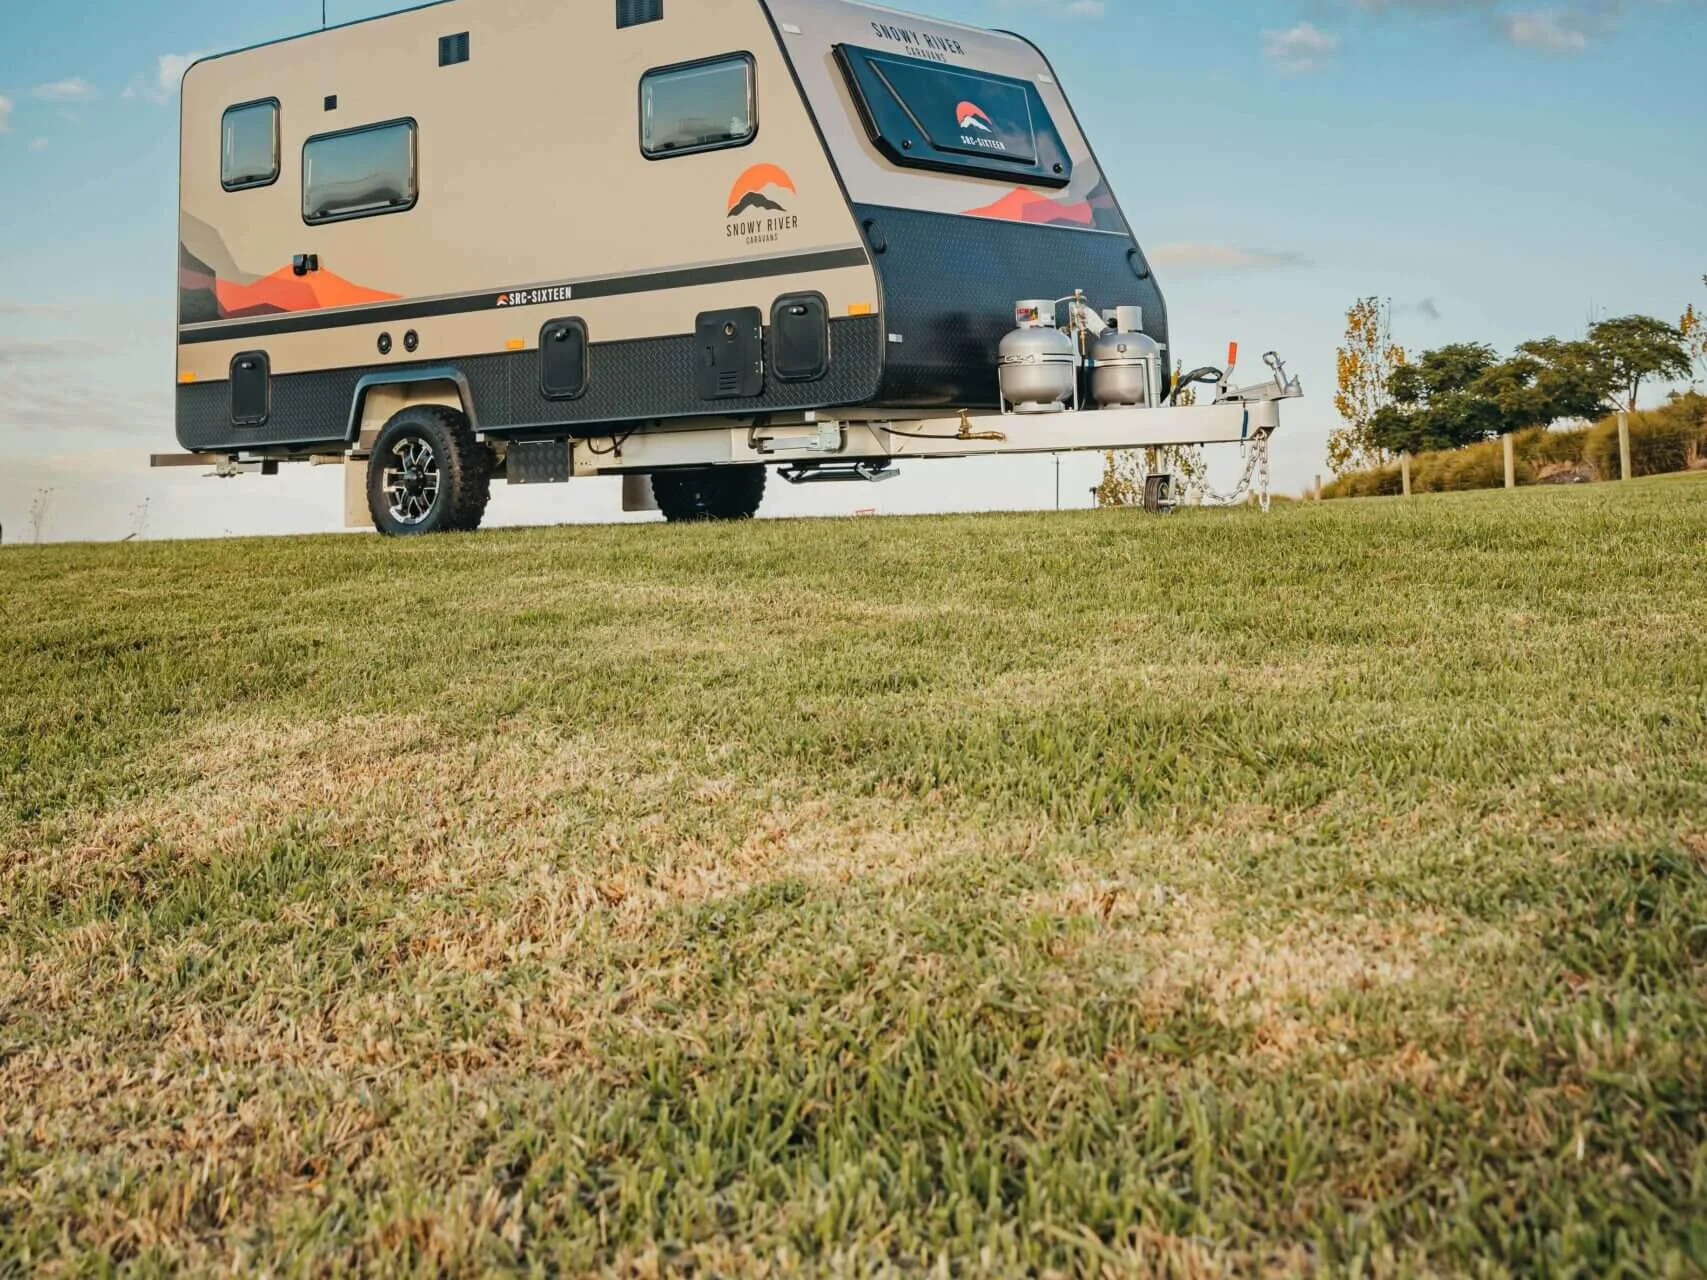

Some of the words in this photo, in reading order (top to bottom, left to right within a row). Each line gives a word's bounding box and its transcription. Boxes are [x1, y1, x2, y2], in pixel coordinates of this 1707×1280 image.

[871, 22, 920, 46] SNOWY
[922, 33, 965, 55] RIVER
[905, 46, 946, 63] CARAVANS
[960, 135, 1006, 150] SRC-SIXTEEN
[726, 220, 762, 237] SNOWY
[767, 215, 798, 231] RIVER
[746, 233, 778, 245] CARAVANS
[509, 286, 572, 305] SRC-SIXTEEN
